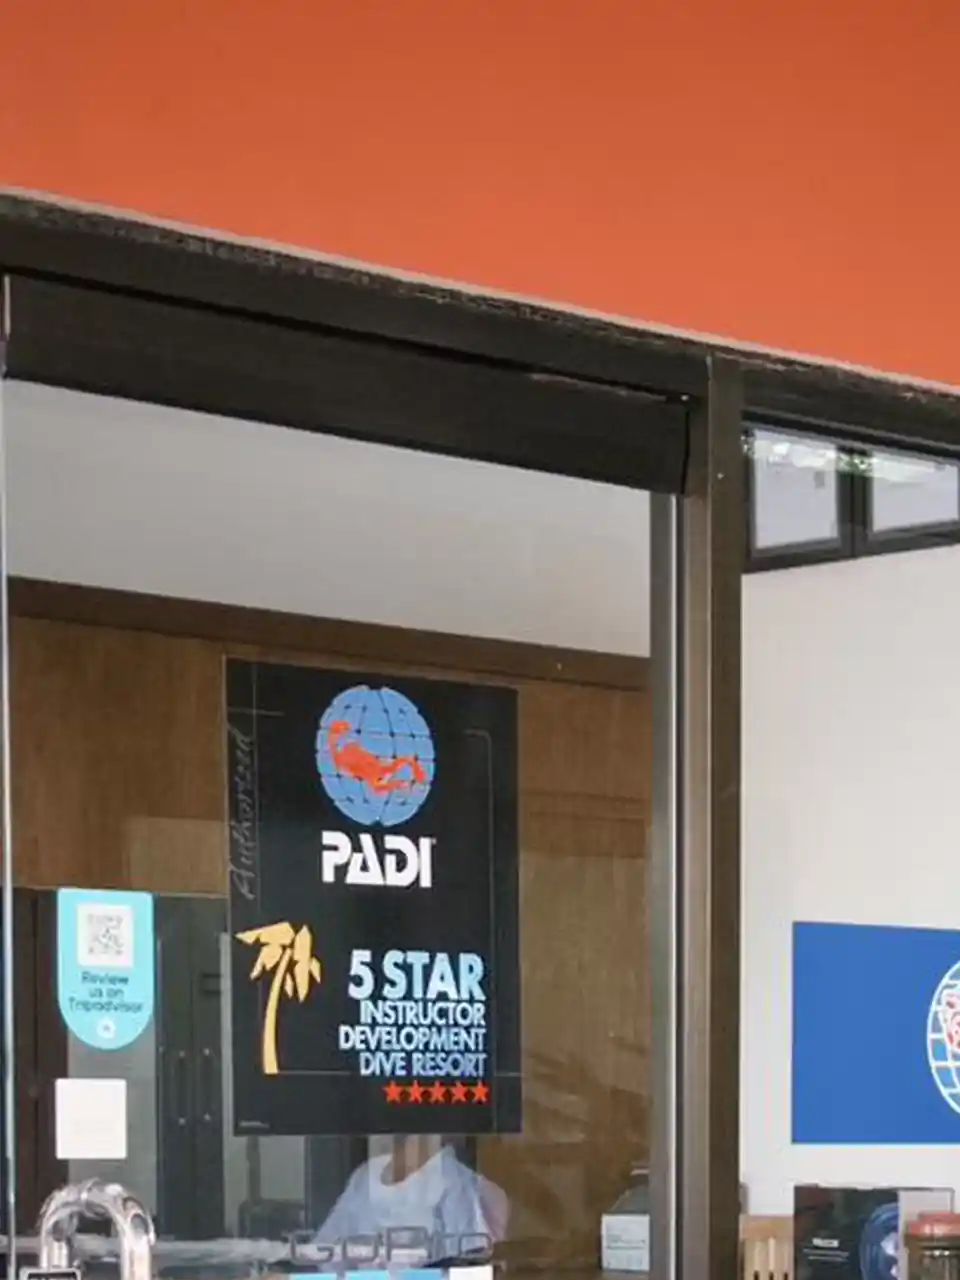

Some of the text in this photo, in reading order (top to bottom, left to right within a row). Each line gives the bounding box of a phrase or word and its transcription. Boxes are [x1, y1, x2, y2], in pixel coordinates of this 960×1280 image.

[321, 831, 433, 888] PADI
[81, 971, 129, 985] Review
[348, 949, 486, 1001] 5 STAR
[106, 987, 125, 998] on
[360, 1000, 486, 1025] INSTRUCTOR
[338, 1024, 487, 1051] DEVELOPMENT
[359, 1051, 487, 1077] DIVE RESORT
